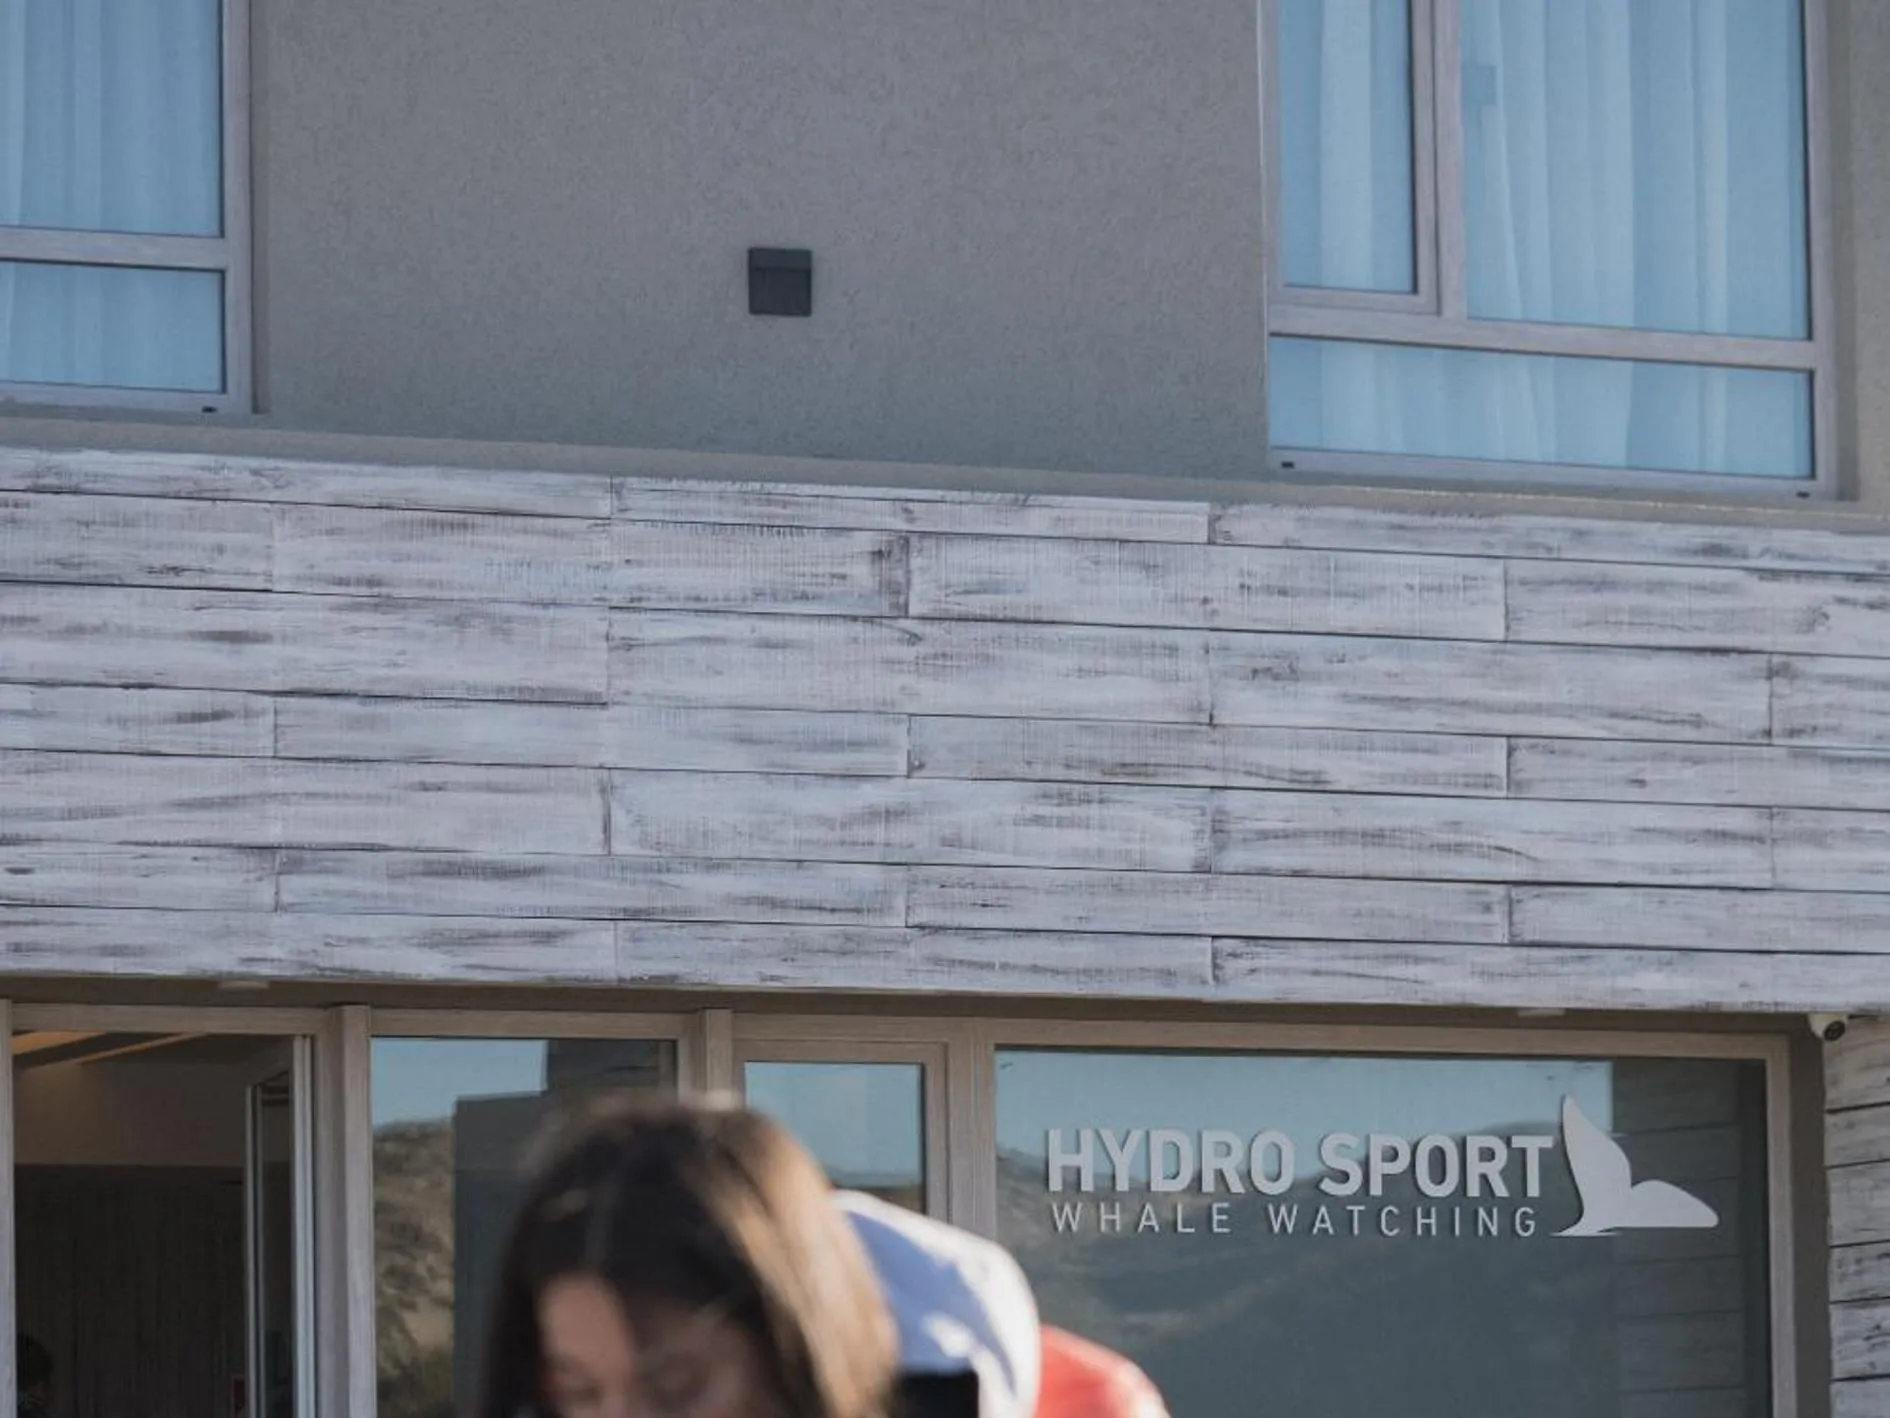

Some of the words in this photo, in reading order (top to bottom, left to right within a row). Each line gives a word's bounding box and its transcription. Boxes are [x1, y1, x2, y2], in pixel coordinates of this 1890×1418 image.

[1048, 1128, 1295, 1196] HYDRO
[1318, 1132, 1554, 1198] SPORT
[1052, 1202, 1232, 1234] WHALE
[1267, 1203, 1536, 1237] WATCHING
